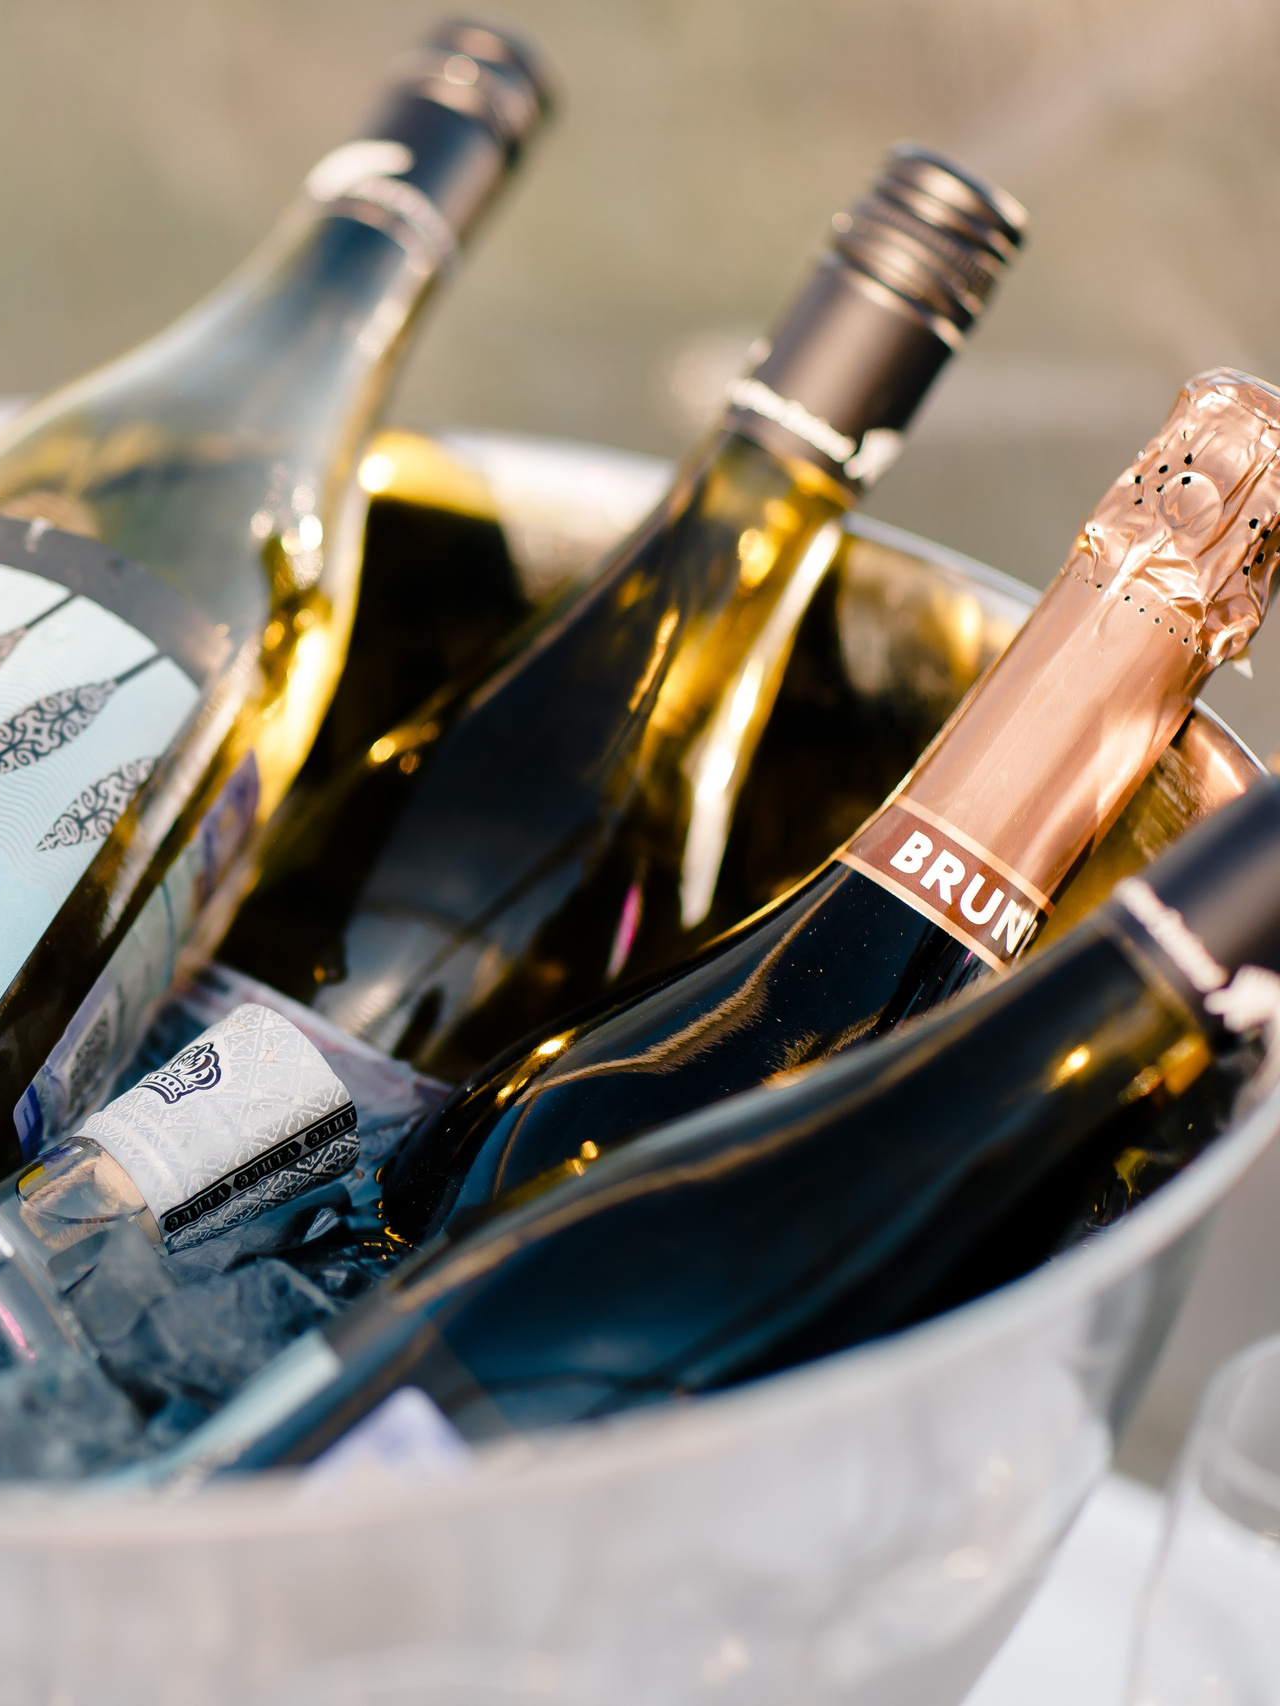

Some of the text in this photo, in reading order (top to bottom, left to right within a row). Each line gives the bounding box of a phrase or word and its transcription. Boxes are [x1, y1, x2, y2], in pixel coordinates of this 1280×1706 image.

[169, 1109, 356, 1230] ЭЛИТА ЭЛИТА ЭЛИТ
